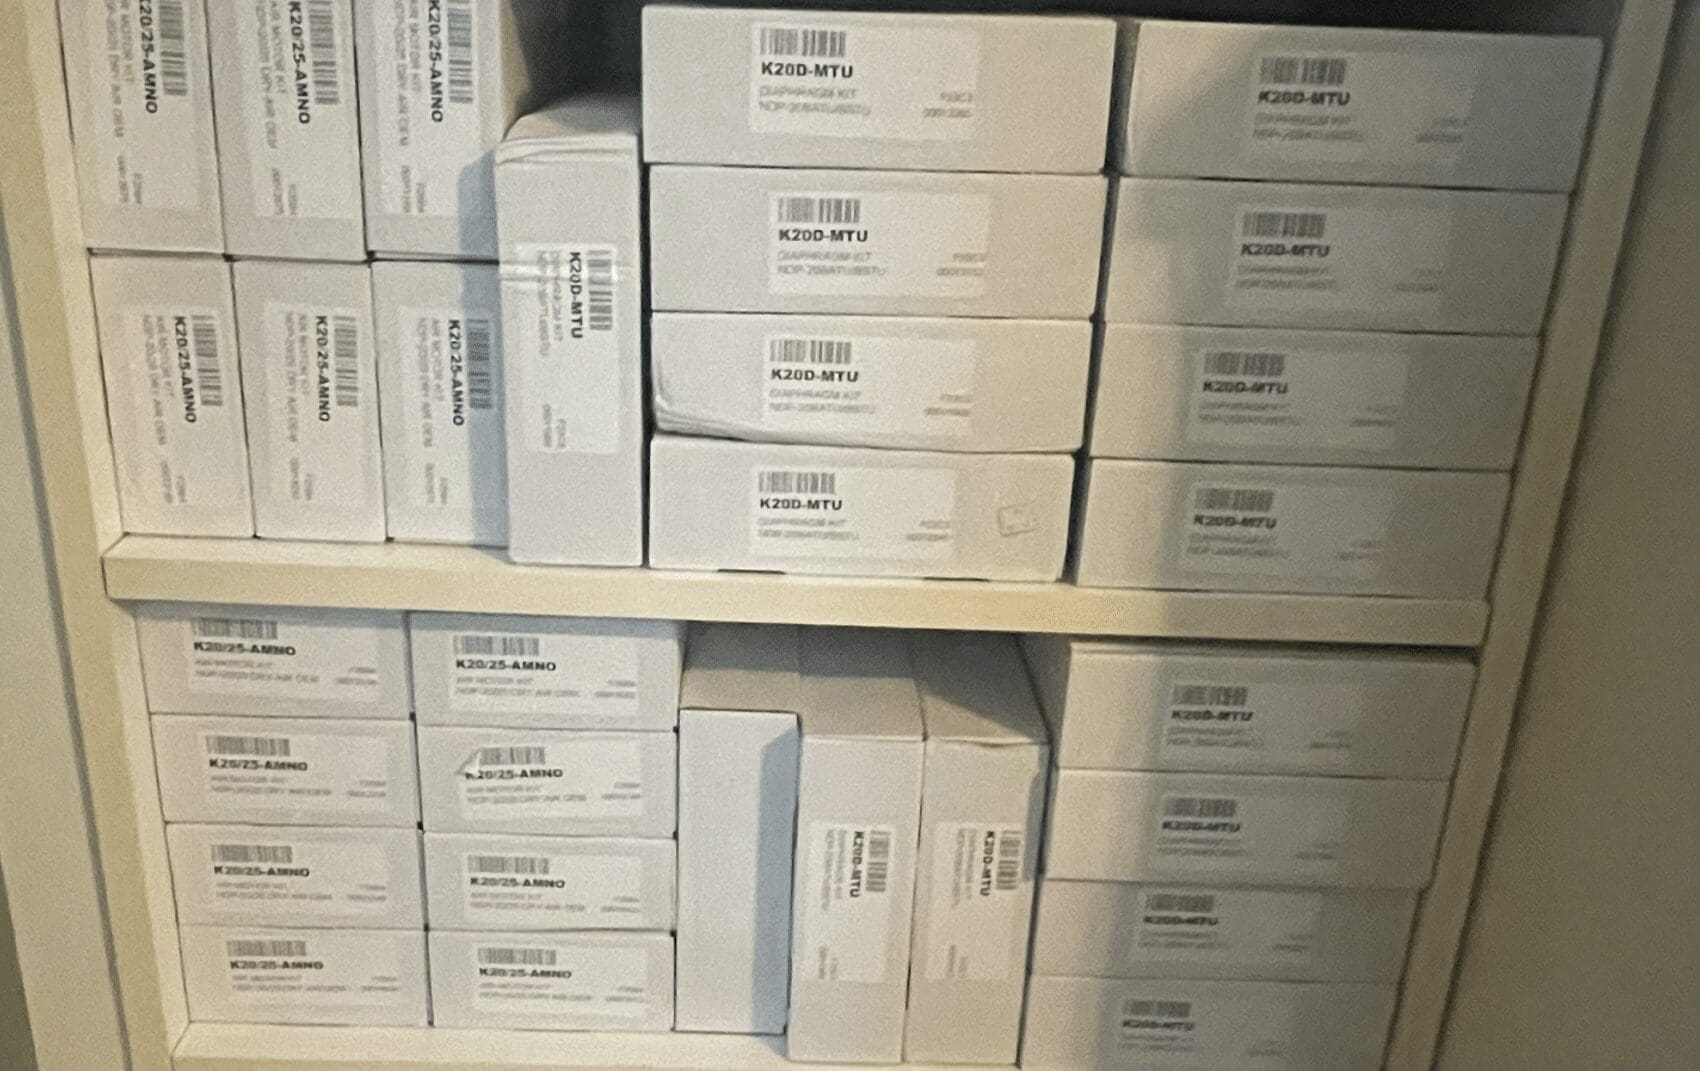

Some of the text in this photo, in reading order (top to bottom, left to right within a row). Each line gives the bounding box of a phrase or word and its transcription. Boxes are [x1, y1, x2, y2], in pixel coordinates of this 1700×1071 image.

[289, 1, 311, 124] K20/25-AMNO
[762, 62, 853, 78] K20D-MTU
[1259, 91, 1350, 106] K20D-MTU
[779, 229, 868, 242] K20D-MTU
[1241, 244, 1330, 257] K20D-MTU
[569, 252, 583, 338] K20D-MTU
[174, 316, 197, 423] K20/25-AMNO
[316, 316, 330, 421] K20/25-AMNO
[449, 320, 464, 426] K20/25-AMNO
[772, 369, 859, 382] K20D-MTU
[760, 499, 842, 511] K20D-MTU
[456, 660, 556, 671] K20/25-AMNO
